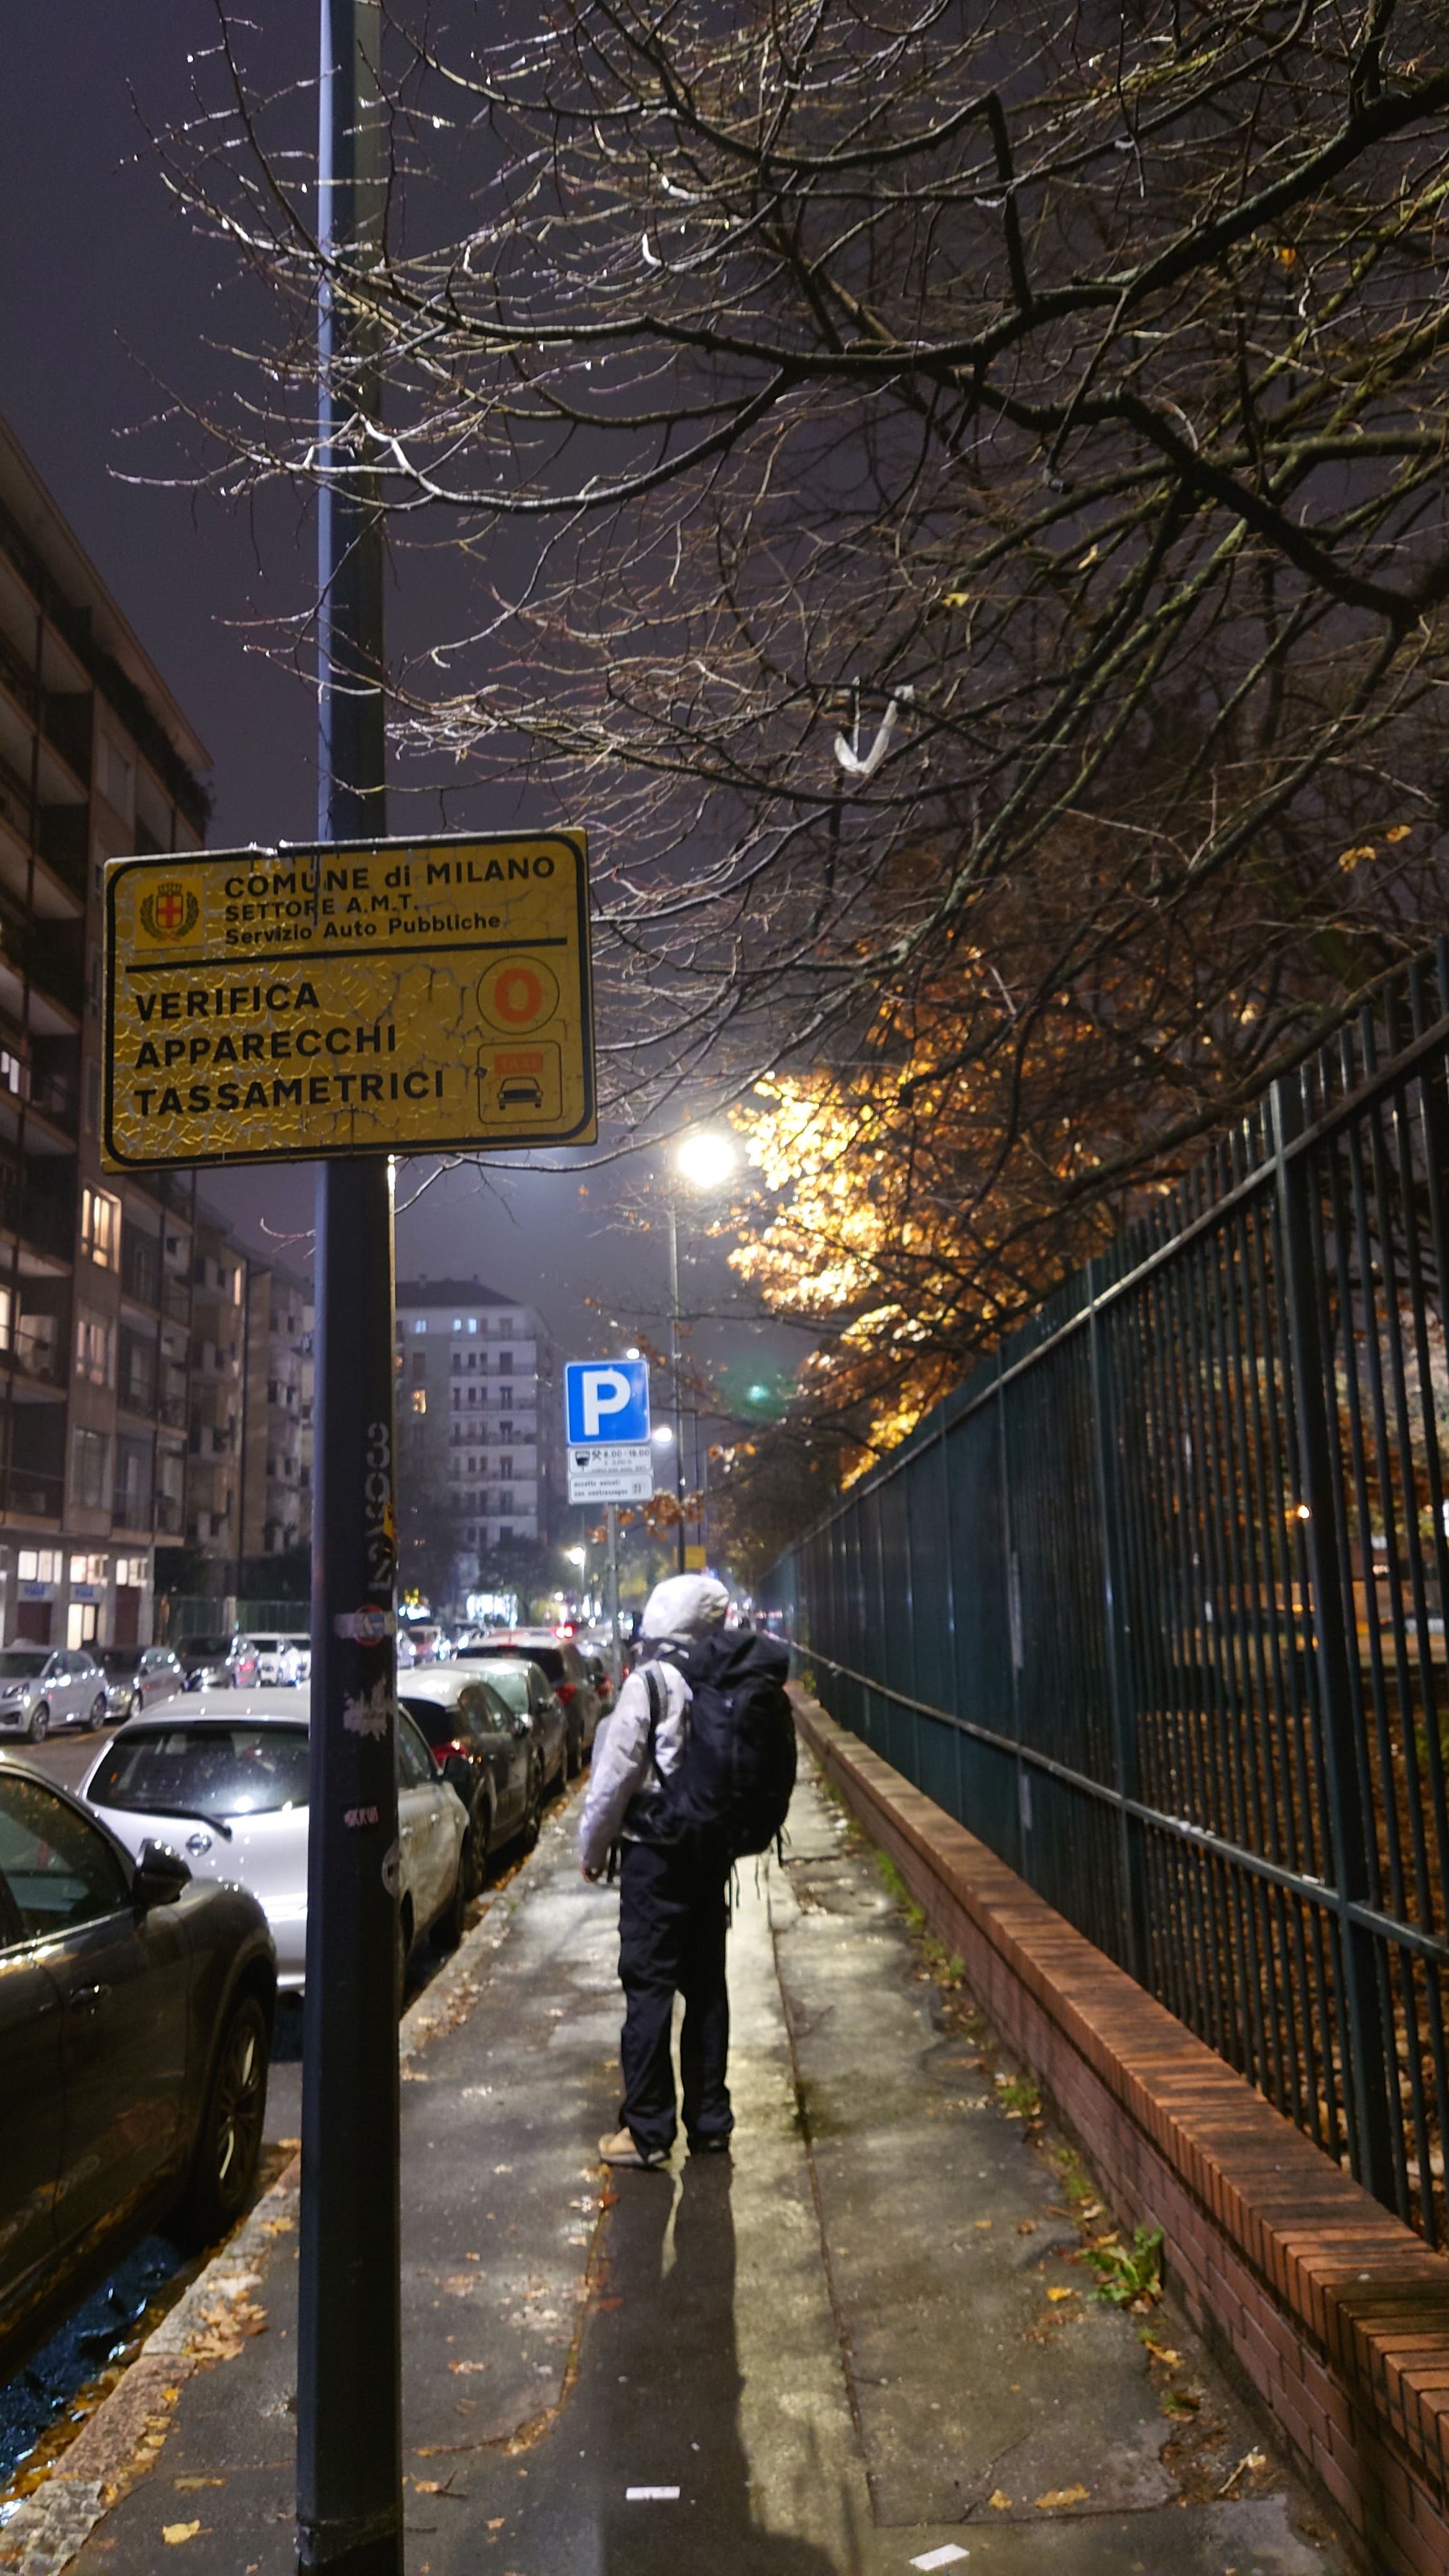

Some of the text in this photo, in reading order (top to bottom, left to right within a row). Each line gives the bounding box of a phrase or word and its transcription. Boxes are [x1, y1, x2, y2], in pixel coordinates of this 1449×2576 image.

[224, 856, 555, 898] COMUNE di MILANO
[224, 893, 418, 922] SETTORE A.M.T.
[225, 911, 500, 945] Servizio Auto Pubbliche
[135, 982, 319, 1021] VERIFICA
[134, 1025, 395, 1070] APPARECCHI
[134, 1070, 443, 1117] TASSAMETRICI
[583, 1370, 631, 1436] P
